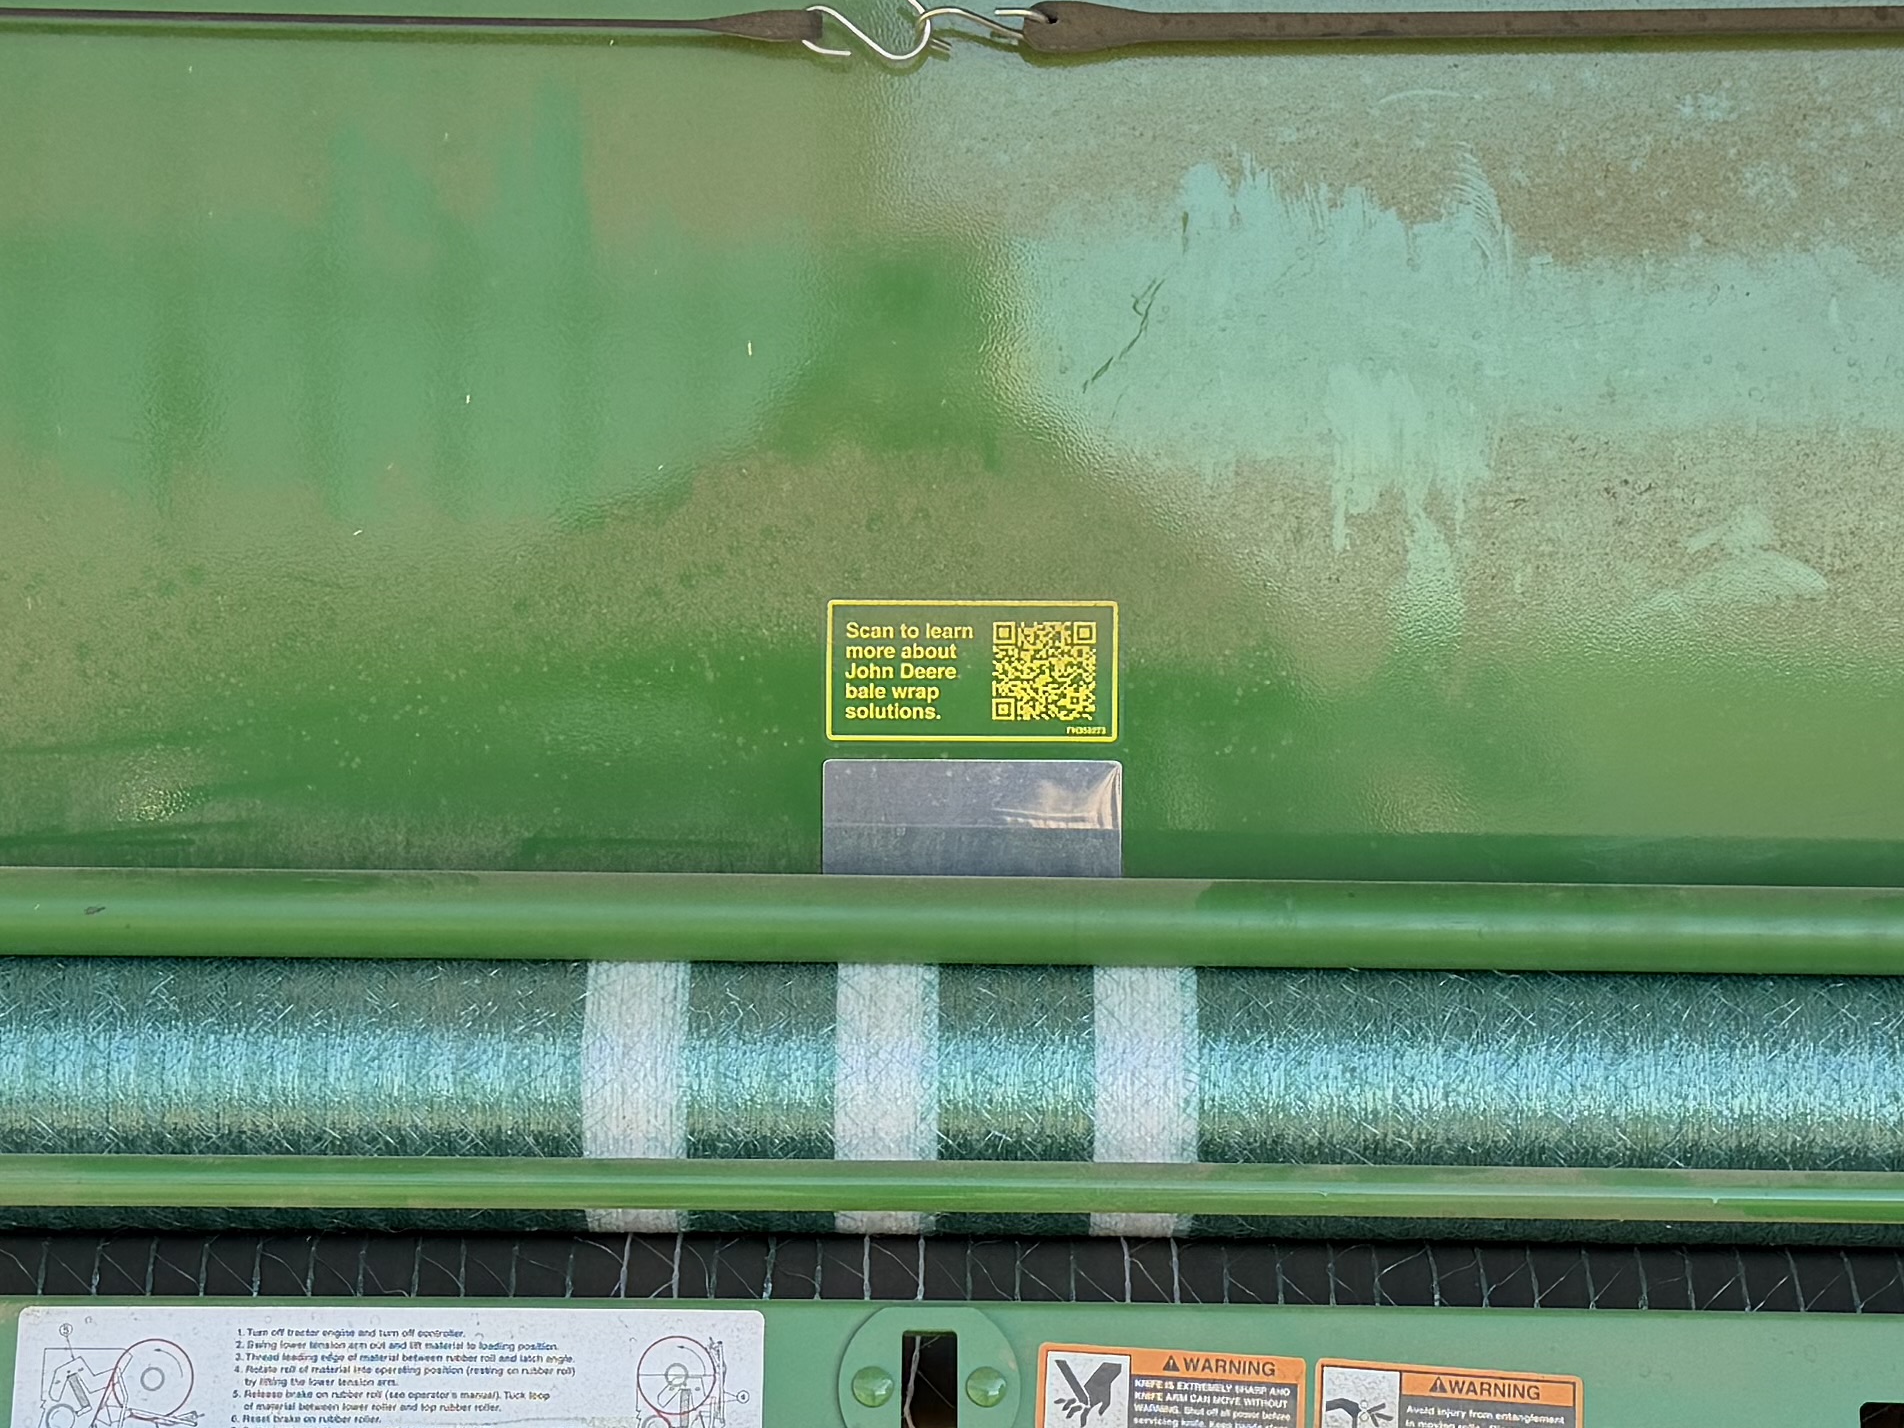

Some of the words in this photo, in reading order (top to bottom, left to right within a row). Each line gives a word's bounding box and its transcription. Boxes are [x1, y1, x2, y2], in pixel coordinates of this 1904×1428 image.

[846, 622, 894, 639] Scan
[900, 623, 919, 639] to
[926, 623, 973, 639] learn
[846, 645, 895, 659] more
[901, 643, 957, 659] about
[845, 663, 893, 679] John
[900, 663, 956, 679] Deere
[846, 683, 886, 699] bale
[892, 686, 939, 703] wrap
[845, 703, 941, 719] solutions.
[246, 1328, 268, 1337] Turn
[271, 1328, 285, 1337] off
[322, 1328, 355, 1339] engine
[358, 1328, 376, 1337] and
[379, 1328, 399, 1337] turn
[402, 1328, 415, 1337] off
[280, 1341, 306, 1350] lower
[370, 1341, 386, 1350] out
[388, 1341, 406, 1350] and
[425, 1341, 464, 1350] material
[478, 1341, 514, 1352] loading
[245, 1352, 279, 1361] Thread
[282, 1353, 318, 1364] leading
[360, 1353, 399, 1362] material
[402, 1353, 443, 1362] between
[446, 1353, 478, 1362] rubber
[498, 1354, 516, 1363] and
[520, 1354, 543, 1363] latch
[312, 1365, 351, 1374] material
[374, 1365, 421, 1376] operating
[424, 1365, 464, 1377] position
[466, 1365, 504, 1377] (resting
[1183, 1357, 1275, 1376] WARNING
[338, 1377, 374, 1386] tension
[1165, 1381, 1174, 1390] IS
[286, 1390, 312, 1399] brake
[332, 1390, 363, 1399] rubber
[504, 1390, 526, 1399] Tuck
[528, 1390, 550, 1402] loop
[1449, 1380, 1540, 1400] WARNING
[1135, 1393, 1163, 1401] KNIFE
[1166, 1393, 1187, 1402] ARM
[1190, 1395, 1211, 1404] CAN
[1213, 1396, 1241, 1405] MOVE
[1244, 1399, 1287, 1408] WITHOUT
[256, 1402, 296, 1411] material
[298, 1402, 339, 1411] between
[342, 1402, 368, 1411] lower
[400, 1402, 418, 1411] and
[420, 1402, 436, 1414] top
[439, 1402, 472, 1411] rubber
[1207, 1408, 1218, 1416] off
[273, 1414, 301, 1423] brake
[318, 1415, 351, 1424] rubber
[1407, 1406, 1434, 1415] Avoid
[1437, 1407, 1466, 1420] injury
[1469, 1410, 1493, 1420] from
[1496, 1413, 1564, 1424] entanglement
